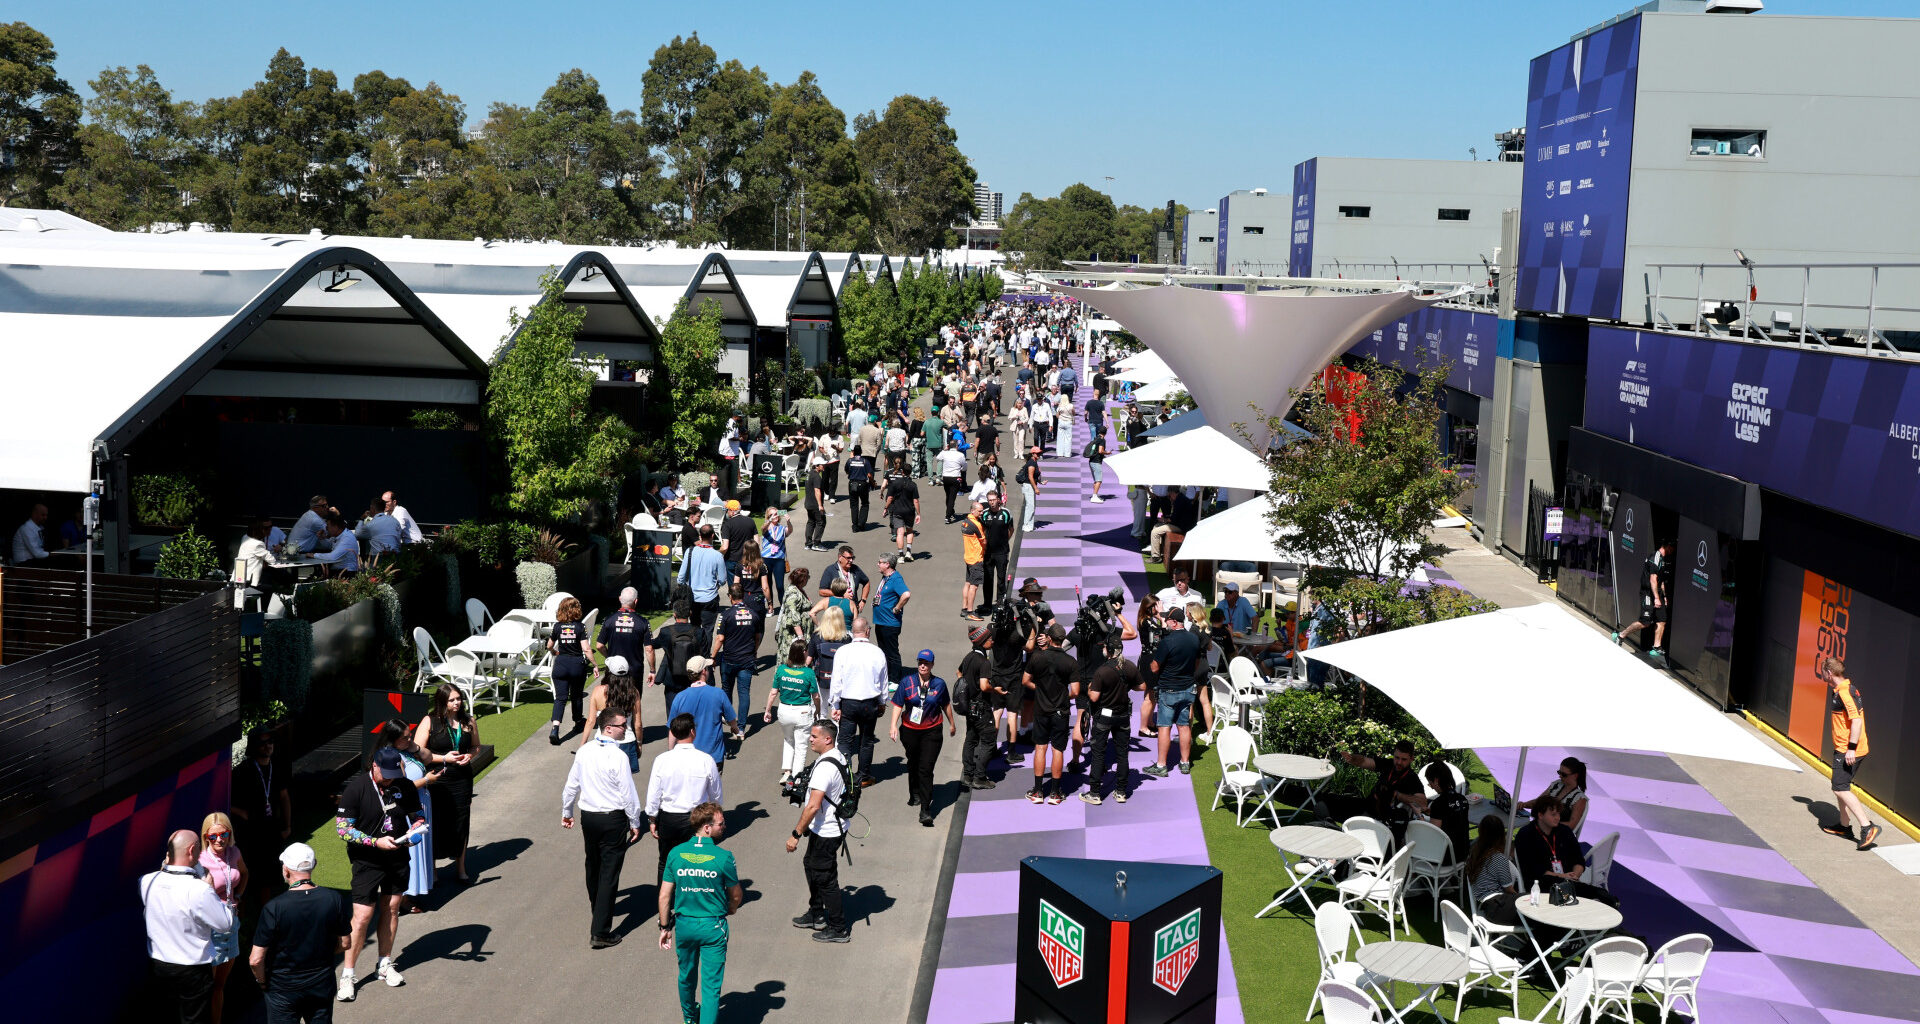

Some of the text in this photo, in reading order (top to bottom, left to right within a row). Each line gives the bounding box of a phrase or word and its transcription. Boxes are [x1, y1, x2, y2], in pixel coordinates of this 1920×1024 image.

[1619, 380, 1650, 397] AUSTRALIAN
[1619, 391, 1648, 408] GRAND PRIX
[1731, 382, 1769, 406] EXPECT
[1727, 400, 1772, 427] NOTHING
[1735, 420, 1760, 443] LESS
[1889, 422, 1920, 442] ALBER
[781, 676, 804, 684] aramco
[677, 868, 718, 879] aramco
[1043, 906, 1080, 952] TAG
[1159, 916, 1197, 955] TAG
[1041, 934, 1081, 982] HEUER
[1156, 944, 1197, 989] HEUER
